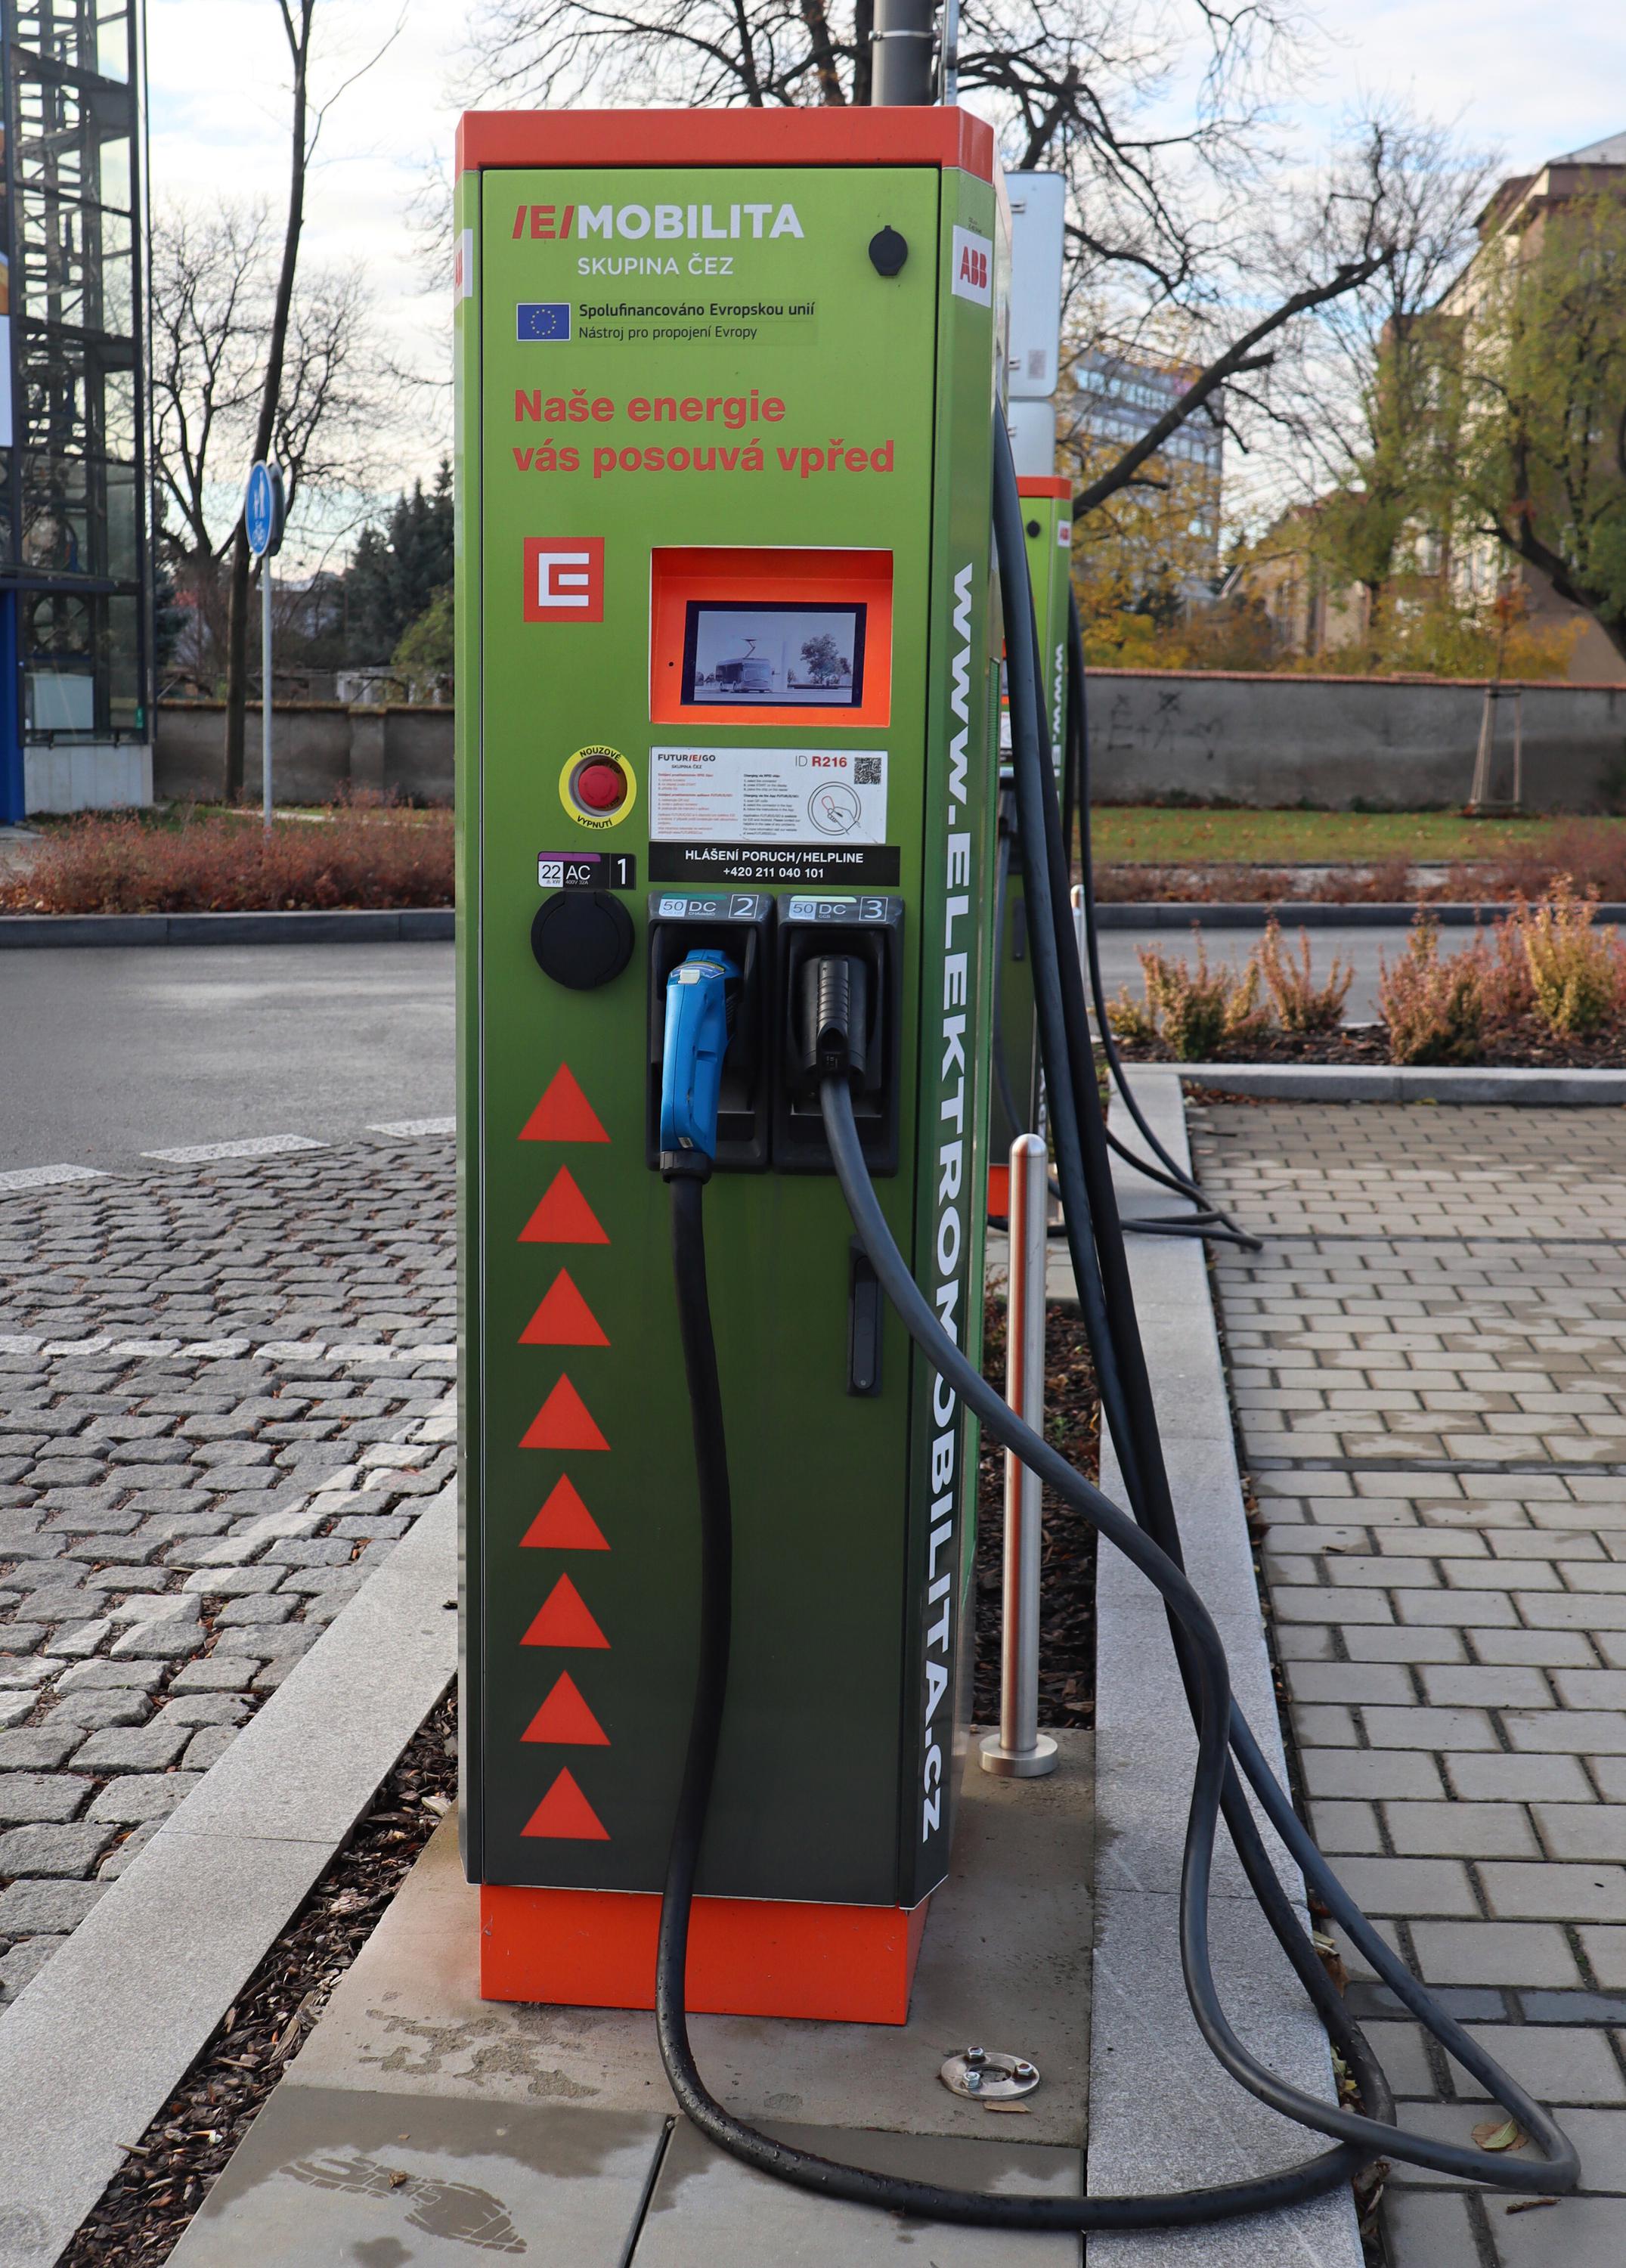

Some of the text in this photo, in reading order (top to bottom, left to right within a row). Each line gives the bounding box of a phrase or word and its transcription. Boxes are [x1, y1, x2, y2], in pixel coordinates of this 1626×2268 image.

[578, 253, 734, 275] SKUPINA ČEZ
[959, 246, 987, 289] ABB
[579, 302, 816, 320] Spolufinancováno Evropskou unií
[579, 325, 757, 342] Nástroj pro propojení Evropy
[515, 389, 785, 429] Naše energie
[513, 438, 894, 479] vás posouvá vpřed
[579, 747, 621, 762] NOUZOVÉ
[795, 755, 847, 767] ID R216
[577, 815, 613, 829] VYPNUTÍ
[685, 848, 739, 861] HLÁŠENÍ
[541, 858, 626, 885] 22 AC 1
[723, 866, 823, 878] +420 211 040 101
[663, 897, 754, 916] 50 DC 2
[793, 900, 882, 919] 50 DC 3
